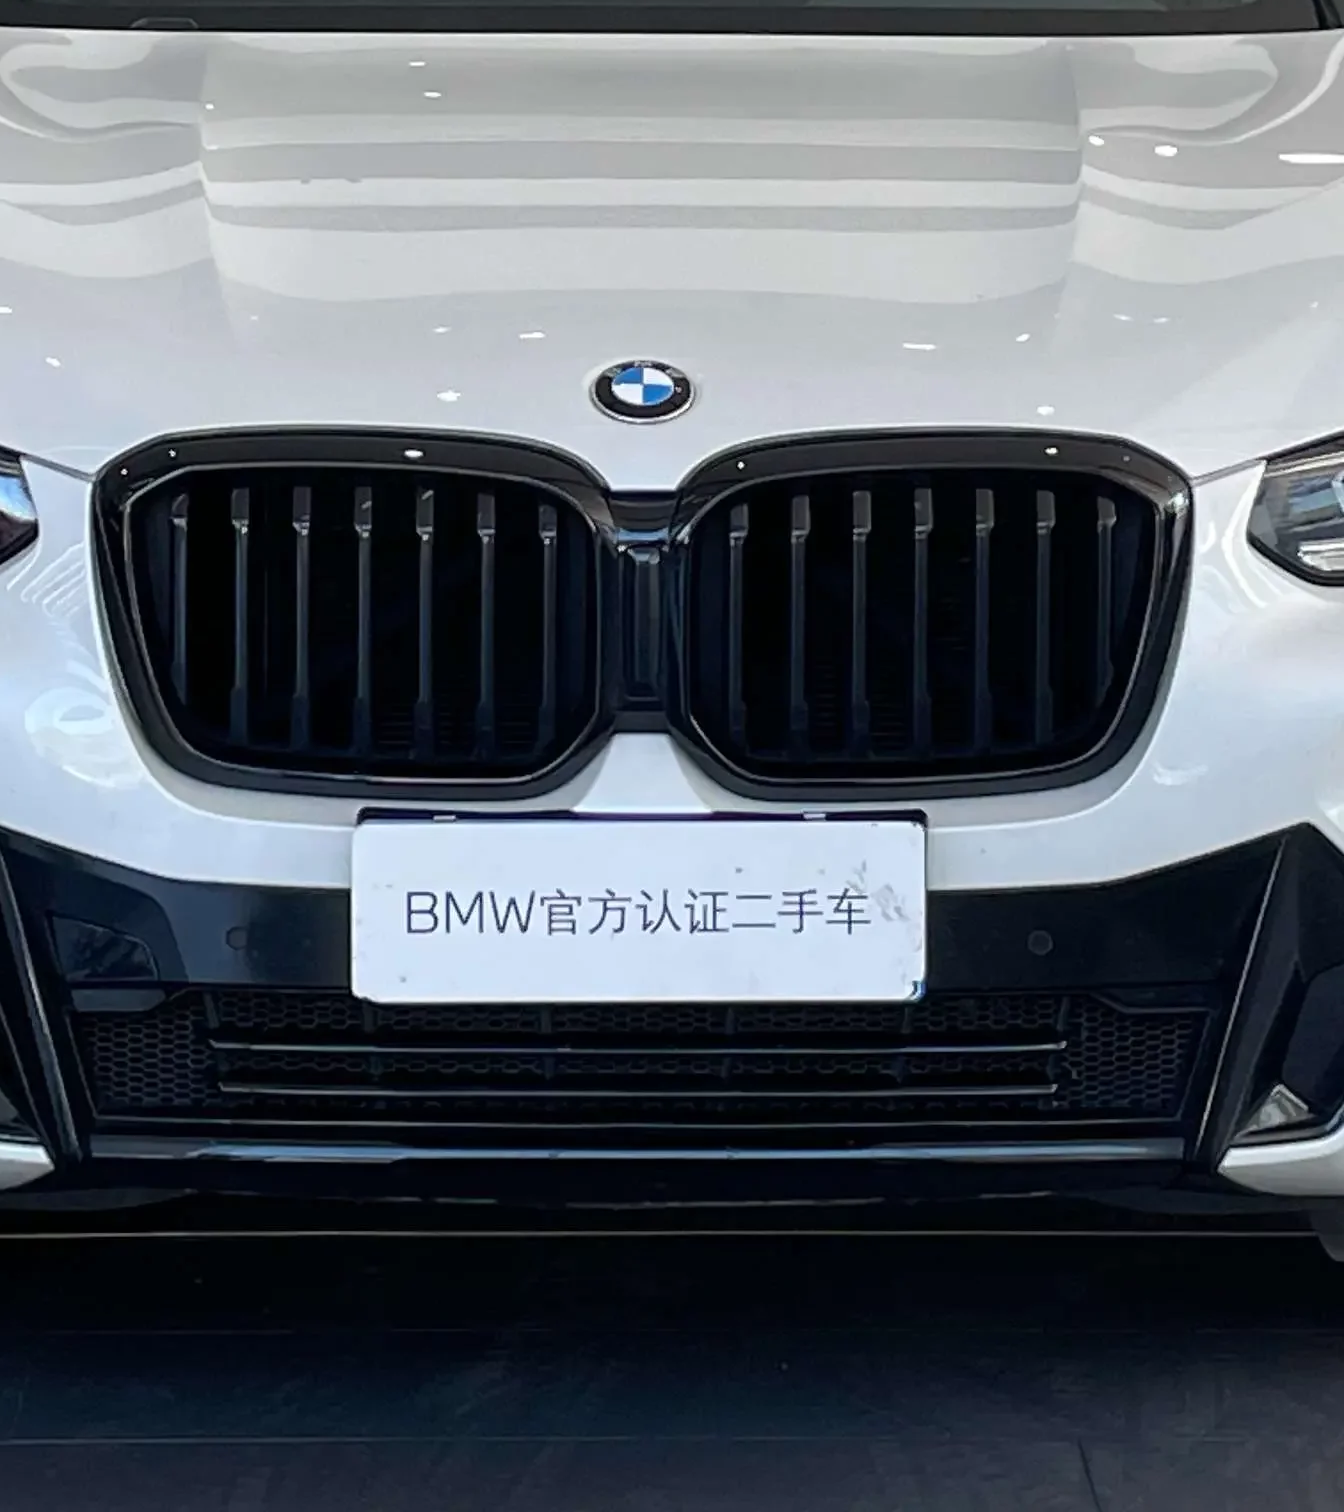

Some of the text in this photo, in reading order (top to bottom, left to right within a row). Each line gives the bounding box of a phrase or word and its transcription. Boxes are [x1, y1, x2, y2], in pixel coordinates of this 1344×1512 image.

[405, 887, 872, 936] BMW官方认证二手车
